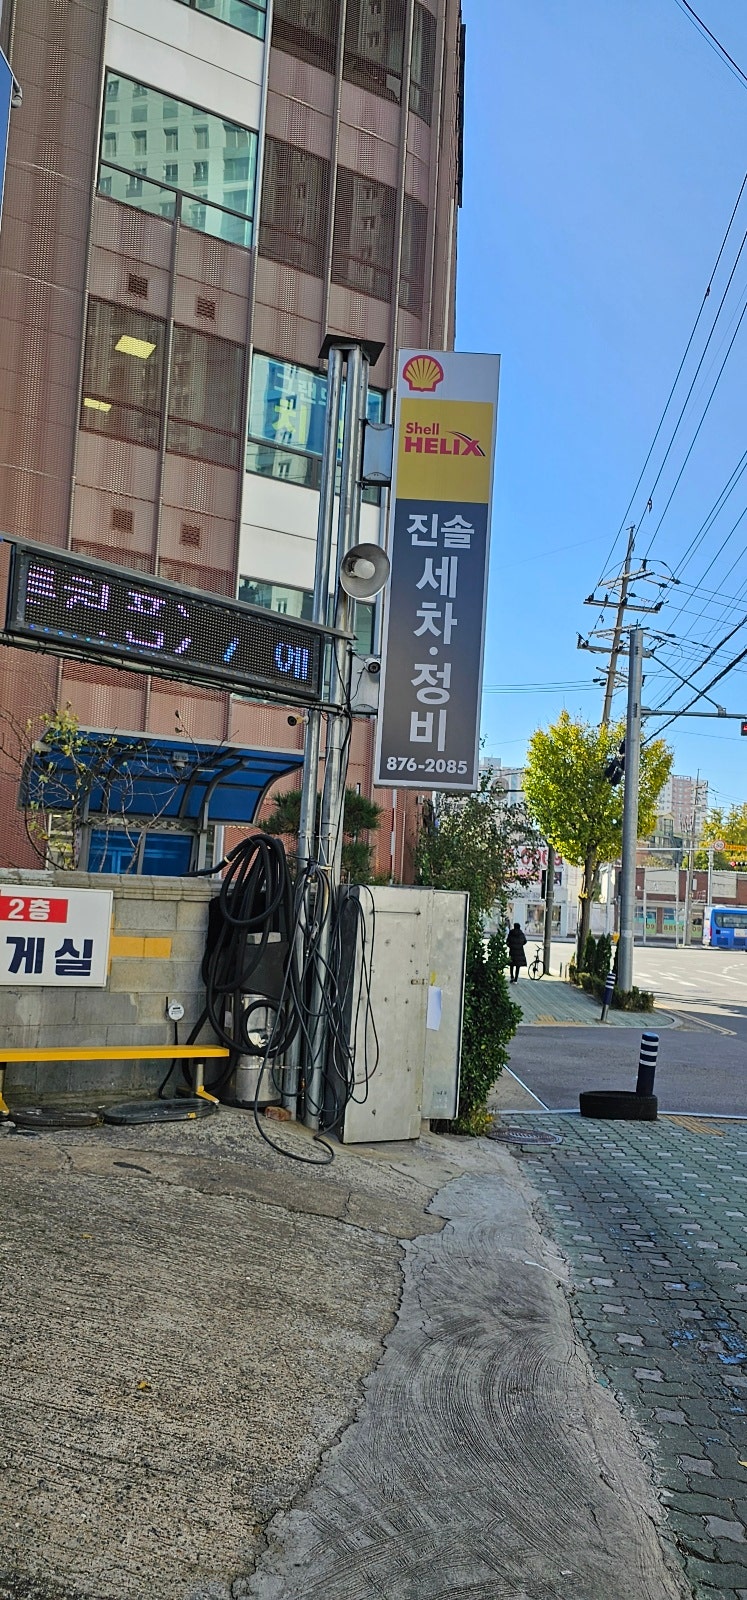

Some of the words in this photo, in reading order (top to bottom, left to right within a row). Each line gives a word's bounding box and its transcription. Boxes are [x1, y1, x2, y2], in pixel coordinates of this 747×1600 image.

[406, 422, 440, 435] Shell
[404, 434, 484, 456] HELIX
[406, 513, 475, 550] 진솔
[275, 642, 309, 680] 에
[386, 757, 468, 774] 876-2085
[7, 898, 51, 921] 2층
[6, 936, 94, 977] 게실
